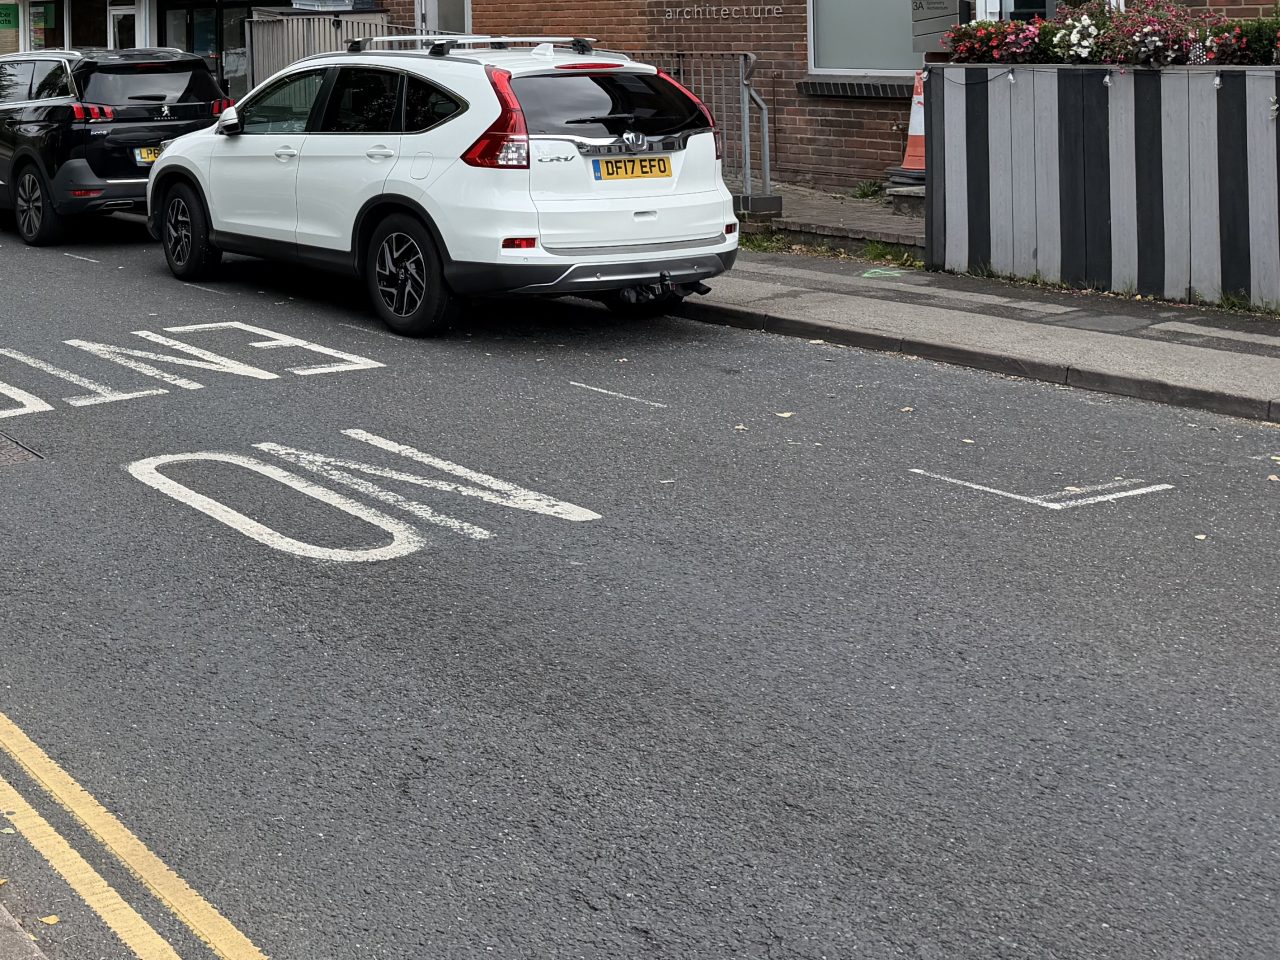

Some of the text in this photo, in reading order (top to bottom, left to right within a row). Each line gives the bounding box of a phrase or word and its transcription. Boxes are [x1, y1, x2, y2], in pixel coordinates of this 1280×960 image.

[665, 3, 784, 20] architecture
[912, 1, 924, 11] 3A
[604, 158, 667, 176] DF17 EFO
[125, 427, 604, 563] NO
